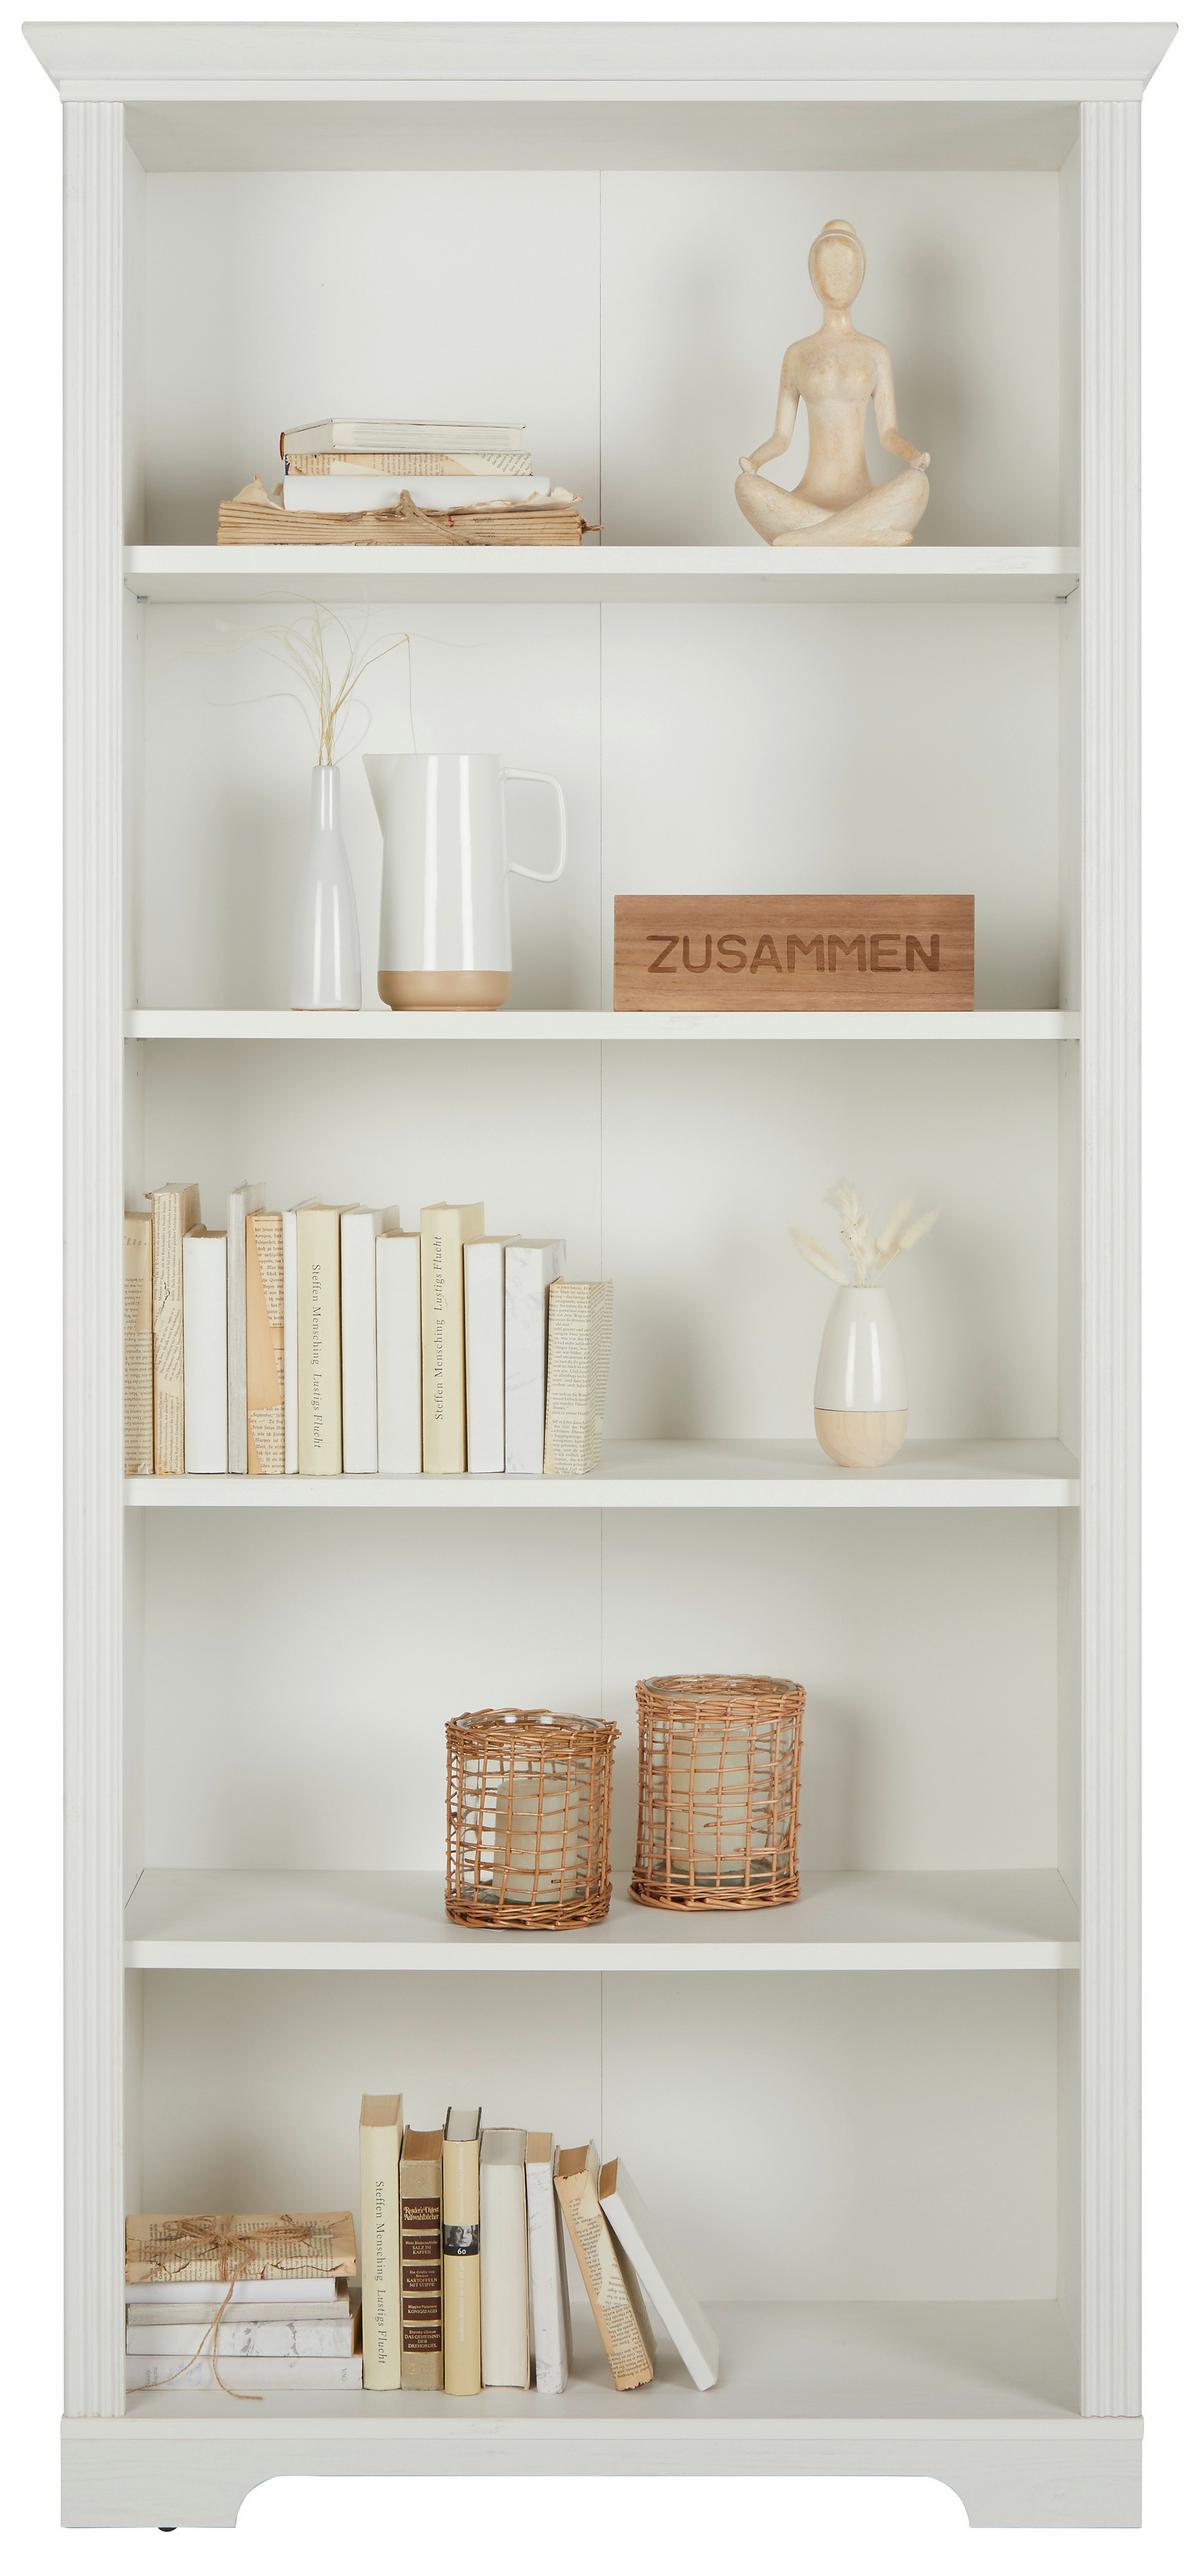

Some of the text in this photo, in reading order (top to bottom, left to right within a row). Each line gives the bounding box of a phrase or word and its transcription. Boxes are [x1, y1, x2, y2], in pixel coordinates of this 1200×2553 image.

[646, 934, 941, 974] ZUSAMMEN
[310, 1264, 323, 1449] Steffen Mensching Lustigs Flucht
[432, 1235, 446, 1421] Steffen Mensching Lustigs Flucht
[374, 2180, 388, 2365] Steffen Mensching Lustigs Flucht
